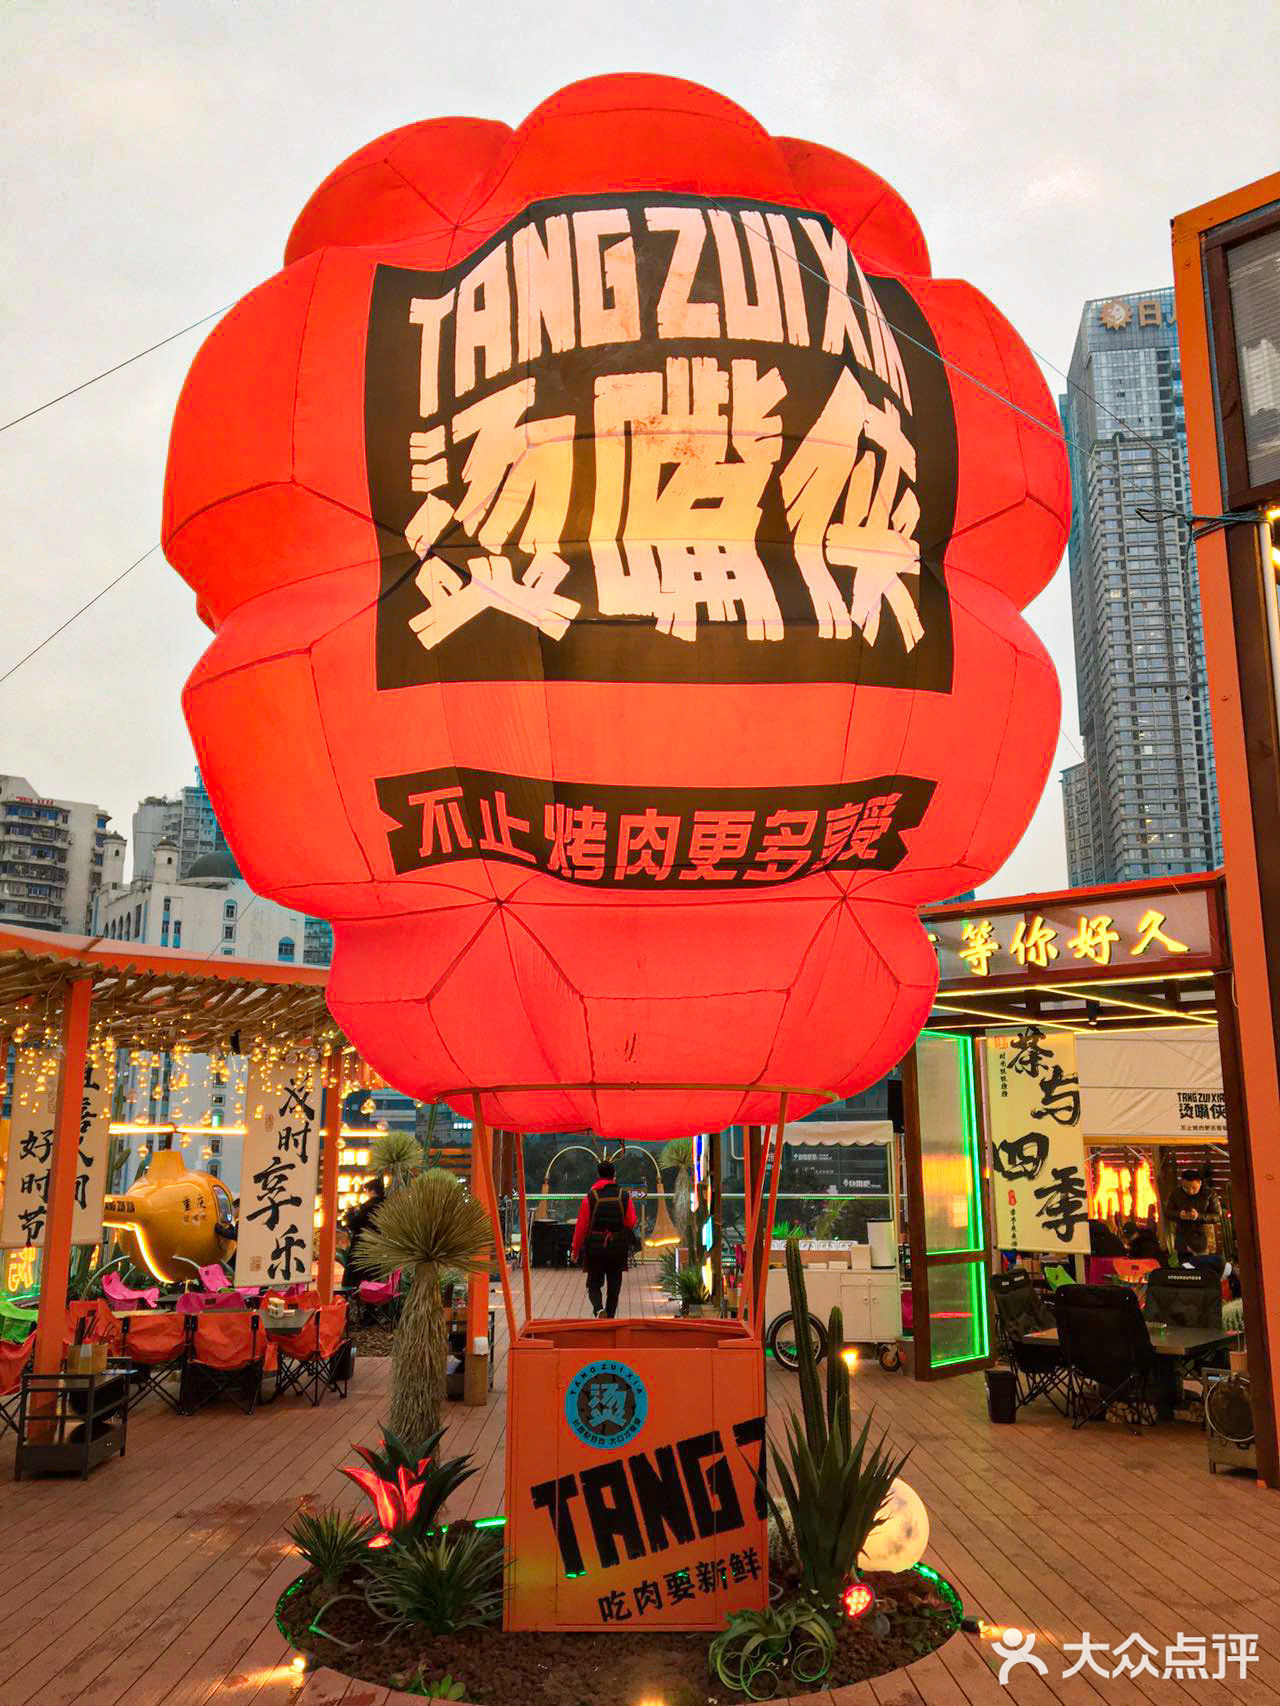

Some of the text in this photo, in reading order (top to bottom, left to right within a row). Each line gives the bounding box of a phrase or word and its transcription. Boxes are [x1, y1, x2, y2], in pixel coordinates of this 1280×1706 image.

[409, 207, 641, 418] TANG
[643, 206, 810, 348] ZUI
[1138, 301, 1176, 326] 日
[404, 357, 926, 653] 烫嘴侠
[928, 909, 1191, 977] 等你好久
[992, 1024, 1089, 1244] 茶与四季
[1177, 1092, 1197, 1103] TANG
[18, 1129, 54, 1247] 好时节
[530, 1429, 745, 1578] TANG
[597, 1546, 763, 1623] 吃肉要新鲜
